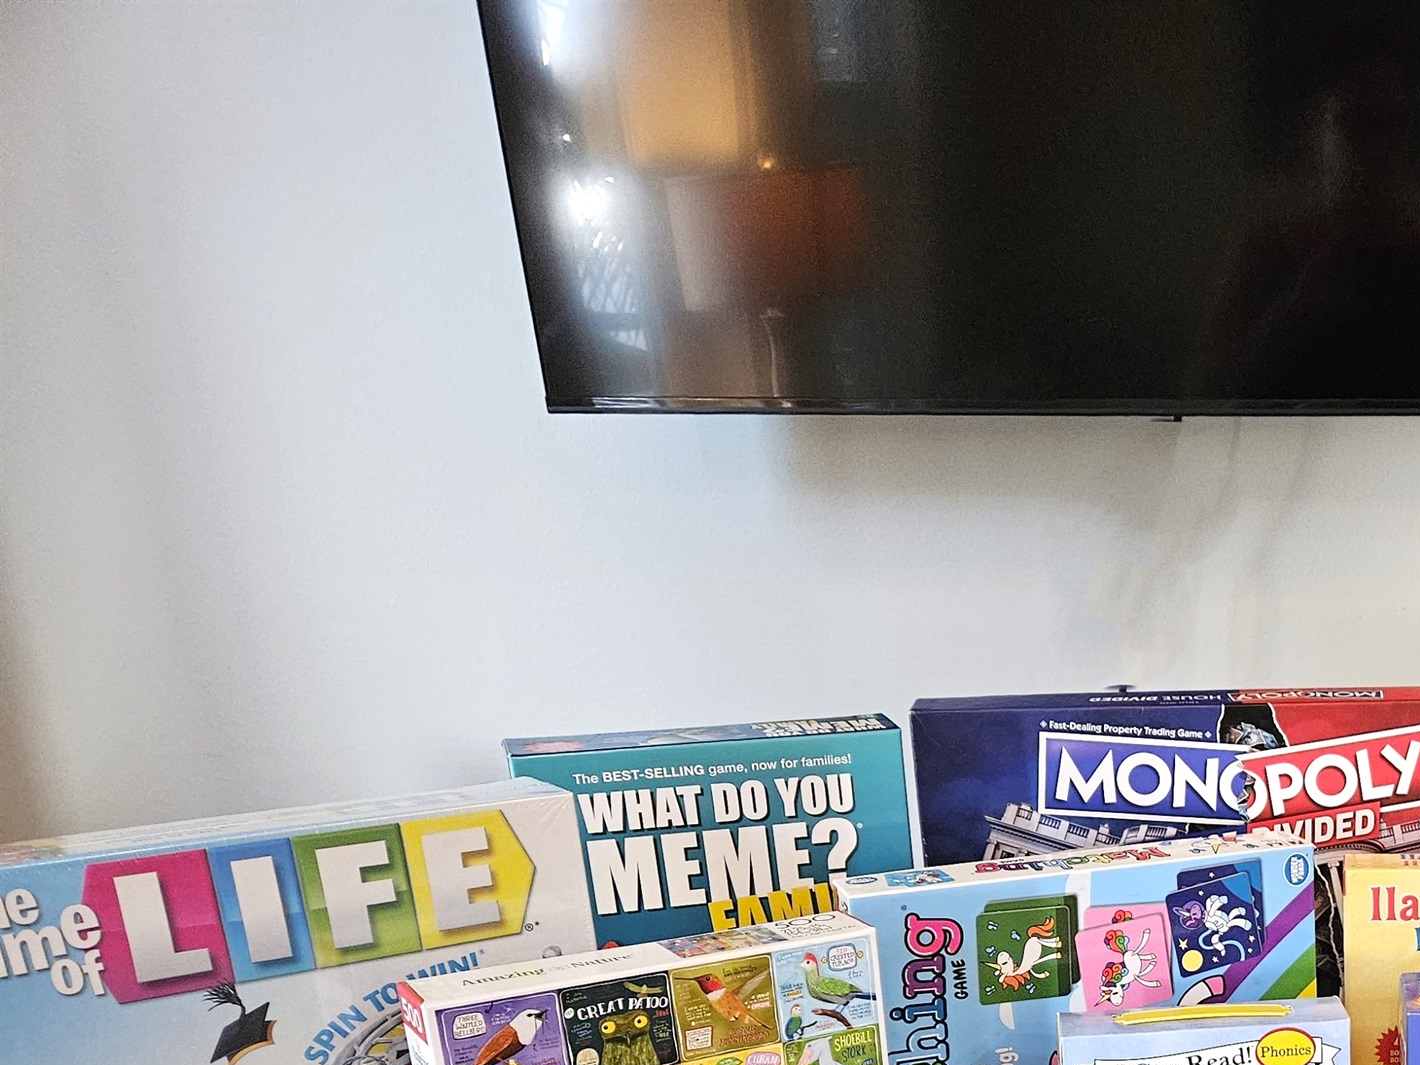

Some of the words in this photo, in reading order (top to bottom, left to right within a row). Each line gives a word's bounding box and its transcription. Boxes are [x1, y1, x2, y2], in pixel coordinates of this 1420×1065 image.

[1049, 721, 1102, 732] Fast-Dealing
[1104, 725, 1142, 736] Property
[1144, 727, 1175, 737] Trading
[1178, 729, 1203, 738] Game
[572, 774, 598, 785] The
[602, 765, 704, 783] BEST-SELLING
[708, 762, 748, 776] game,
[752, 759, 776, 771] now
[781, 758, 798, 768] for
[801, 754, 851, 767] families!
[577, 784, 700, 833] WHAT
[711, 779, 766, 821] DO
[773, 773, 854, 816] YOU
[586, 818, 858, 915] MEME?
[113, 826, 501, 983] LIFE
[708, 882, 832, 932] FAMI
[51, 949, 105, 995] of
[951, 959, 968, 999] GAME
[304, 1005, 367, 1065] SPIN
[363, 983, 400, 1012] TO
[402, 1000, 423, 1034] 500
[1260, 1044, 1312, 1057] Phonics
